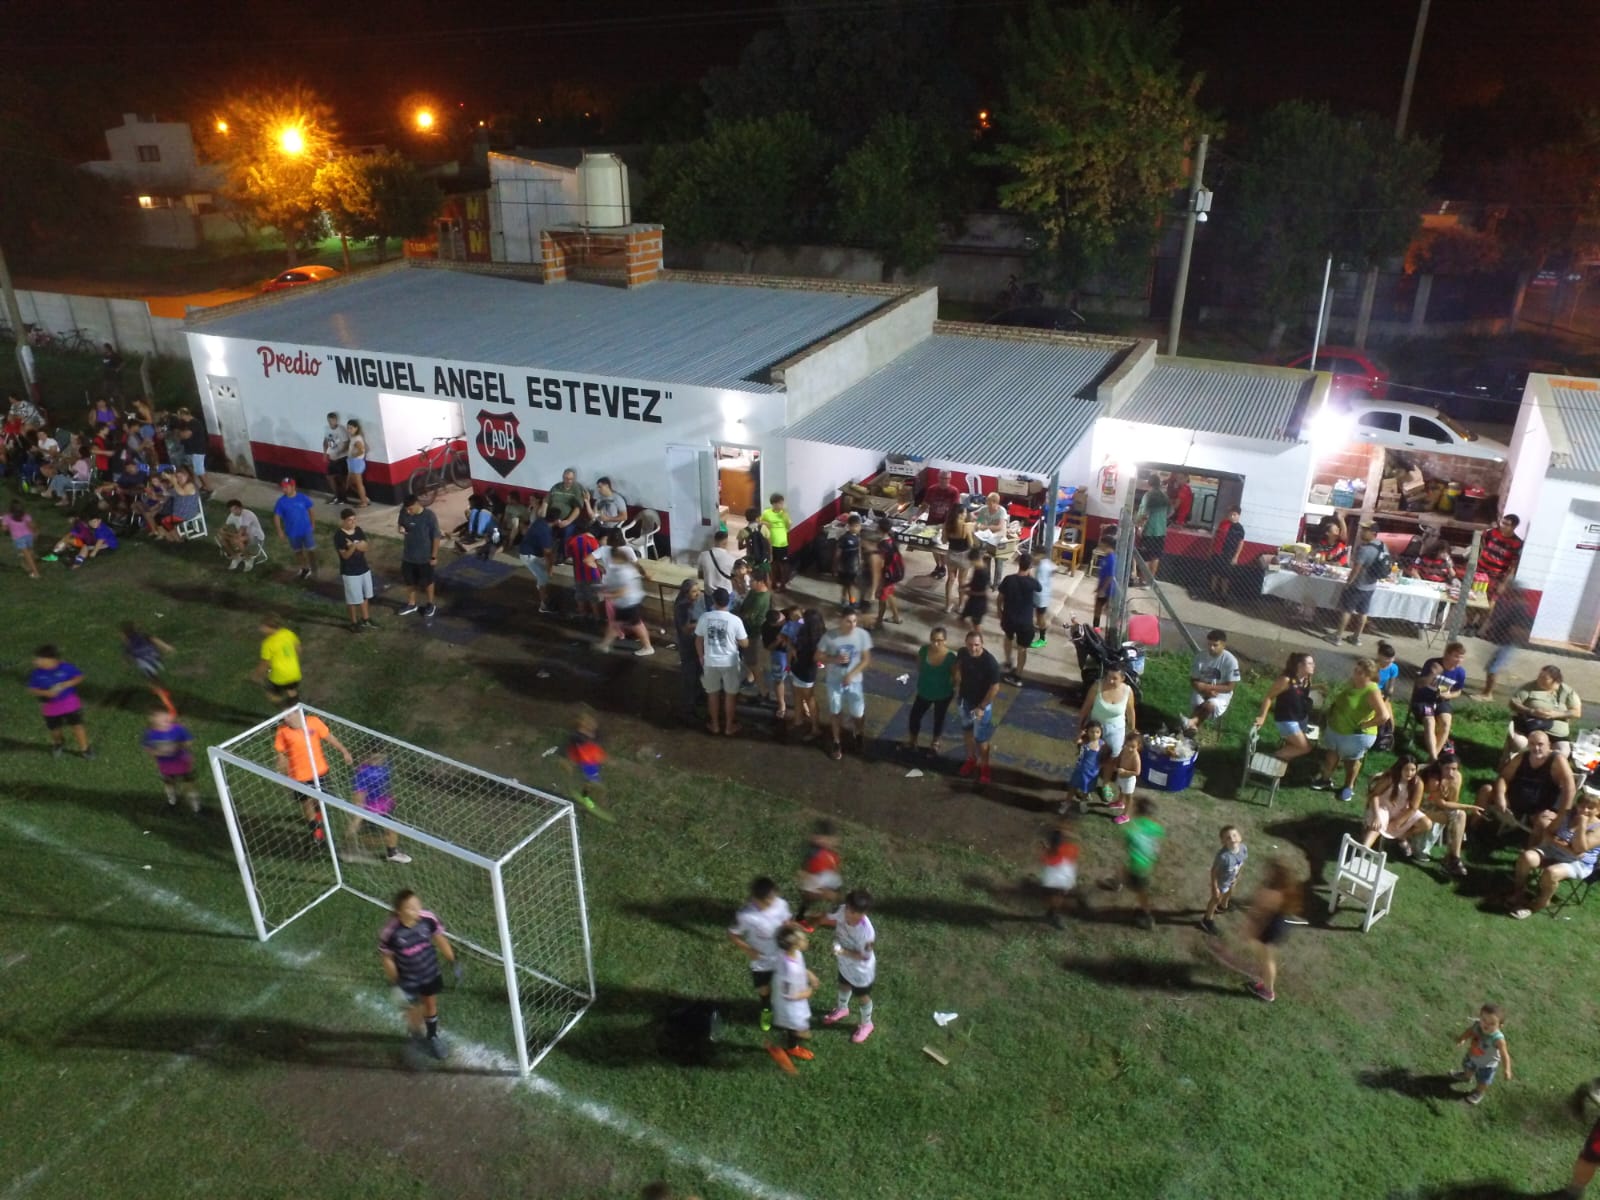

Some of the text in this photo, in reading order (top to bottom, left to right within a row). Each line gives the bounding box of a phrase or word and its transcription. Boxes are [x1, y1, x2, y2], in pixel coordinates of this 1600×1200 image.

[257, 346, 673, 424] Predio "MIGUEL ANGEL ESTEVEZ"
